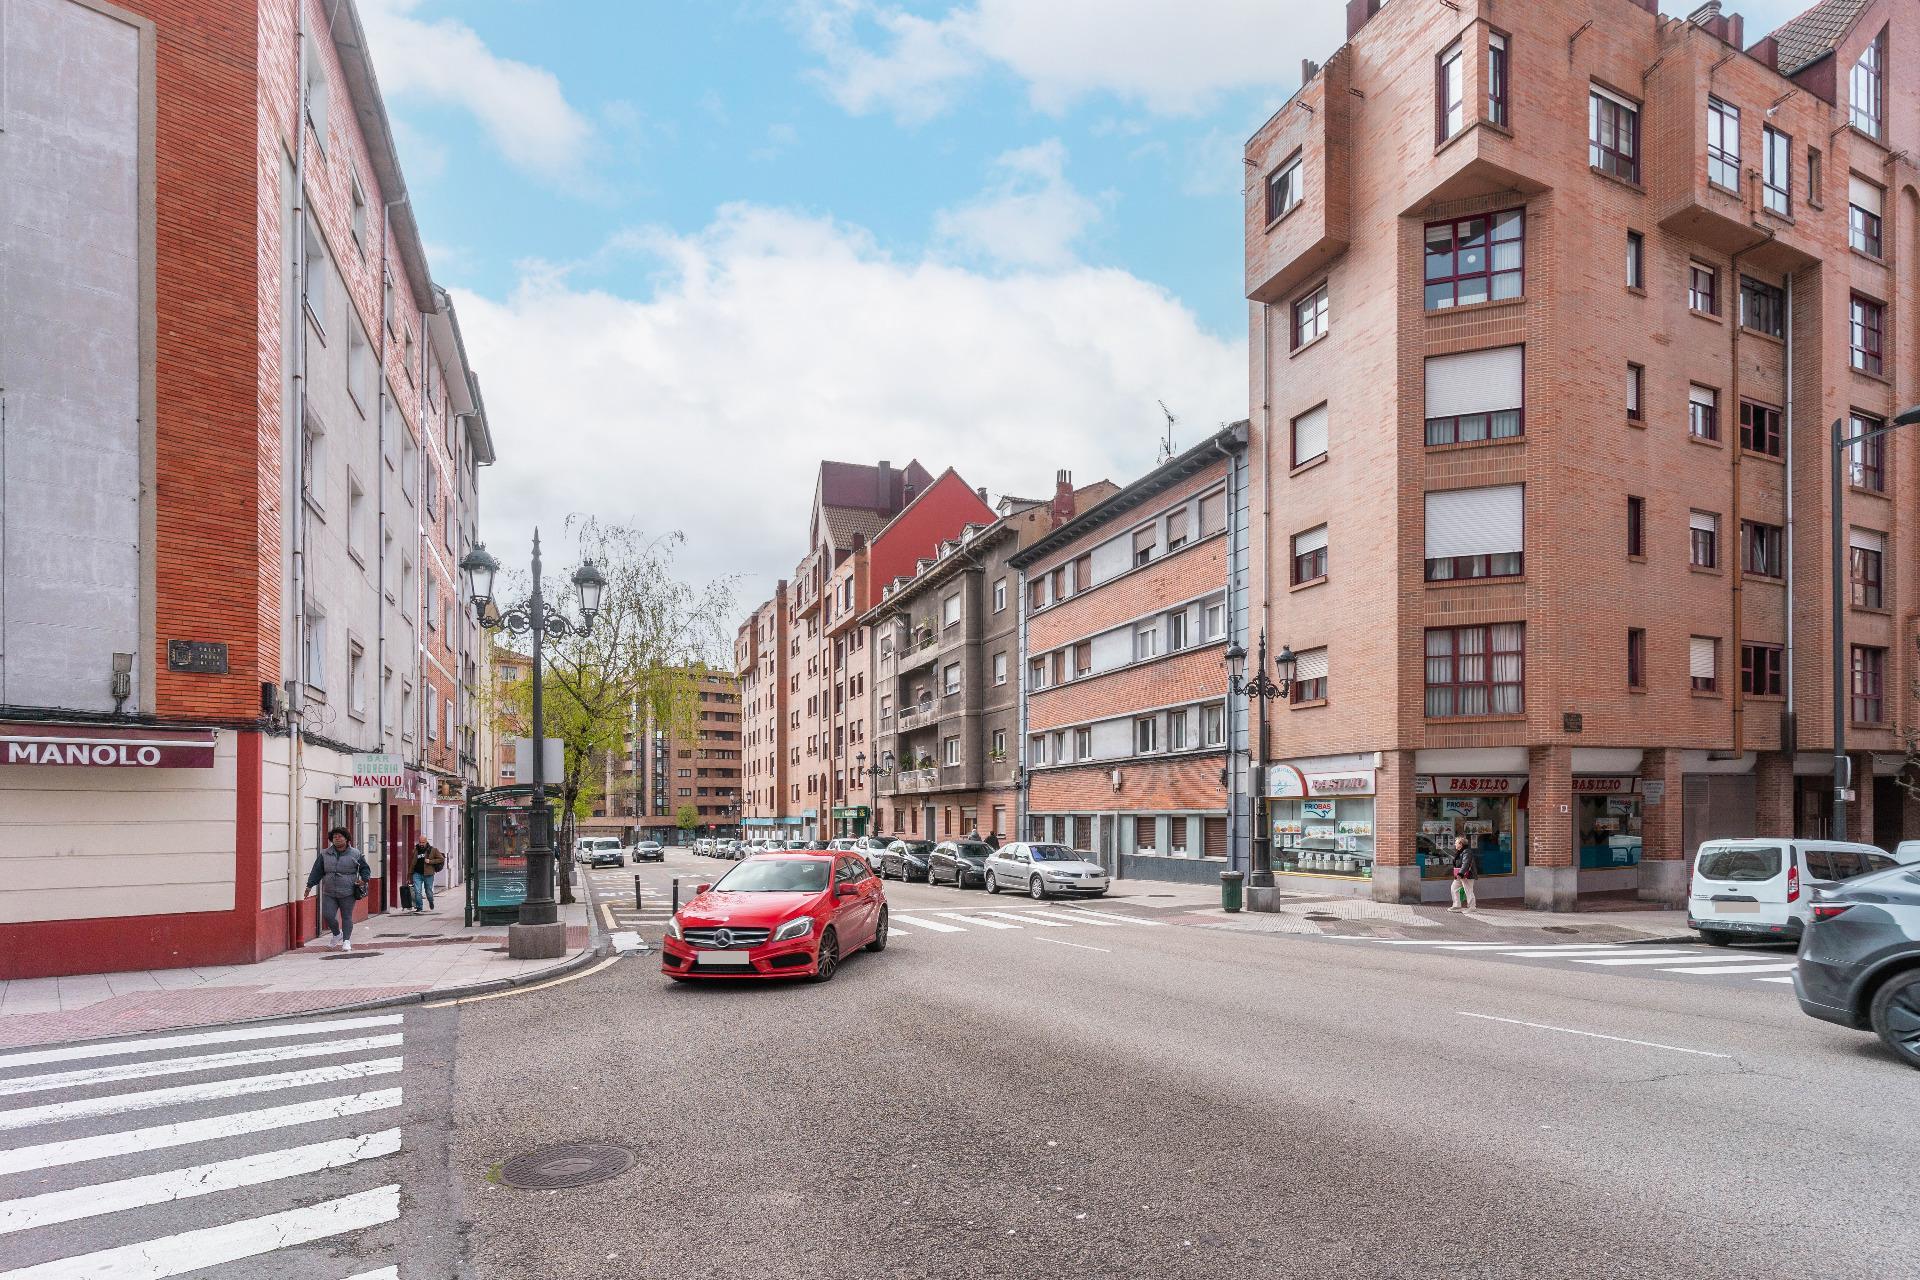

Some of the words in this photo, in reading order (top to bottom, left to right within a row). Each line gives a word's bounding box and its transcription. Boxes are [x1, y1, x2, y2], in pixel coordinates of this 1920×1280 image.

[8, 742, 161, 766] MANOLO
[353, 775, 402, 787] MANOLO
[1311, 777, 1367, 790] BASILIO
[1450, 778, 1510, 792] BASILIO
[1572, 779, 1621, 792] BASILIO
